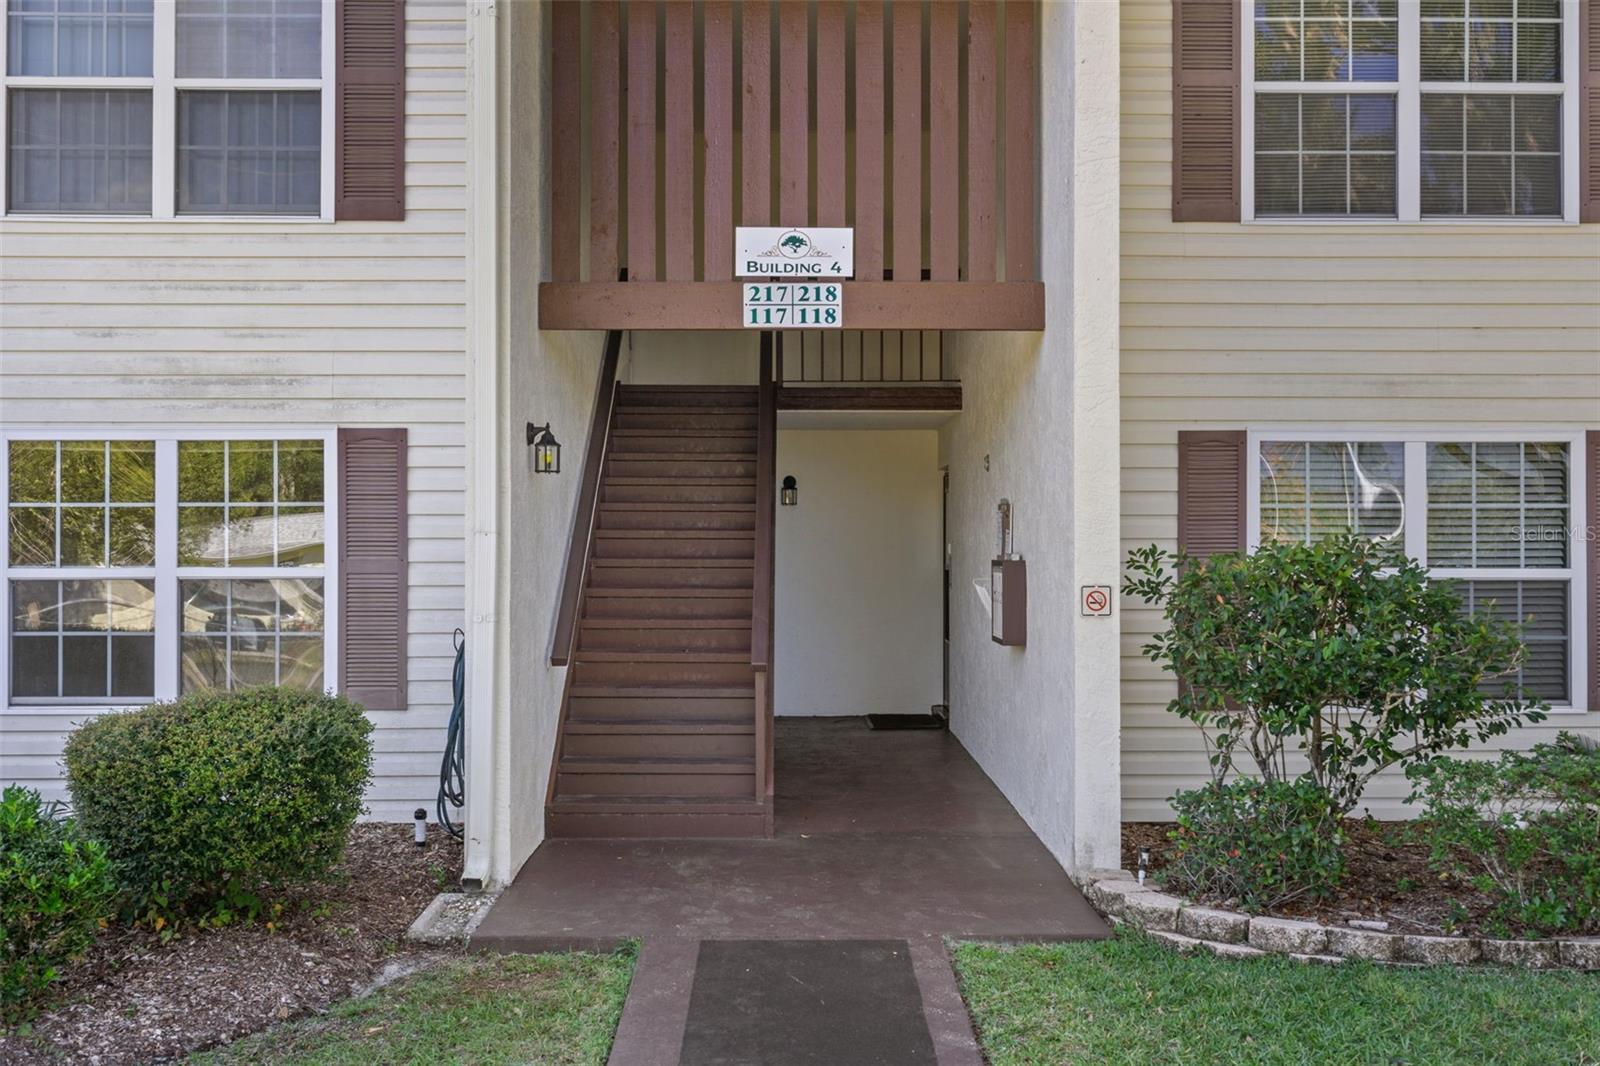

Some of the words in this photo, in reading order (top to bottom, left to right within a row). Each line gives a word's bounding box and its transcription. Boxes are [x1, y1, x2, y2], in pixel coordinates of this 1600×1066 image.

[747, 261, 821, 273] BUILDING
[830, 261, 842, 273] 4
[749, 286, 788, 302] 217
[798, 286, 837, 302] 218
[750, 308, 787, 324] 117
[799, 308, 836, 324] 118
